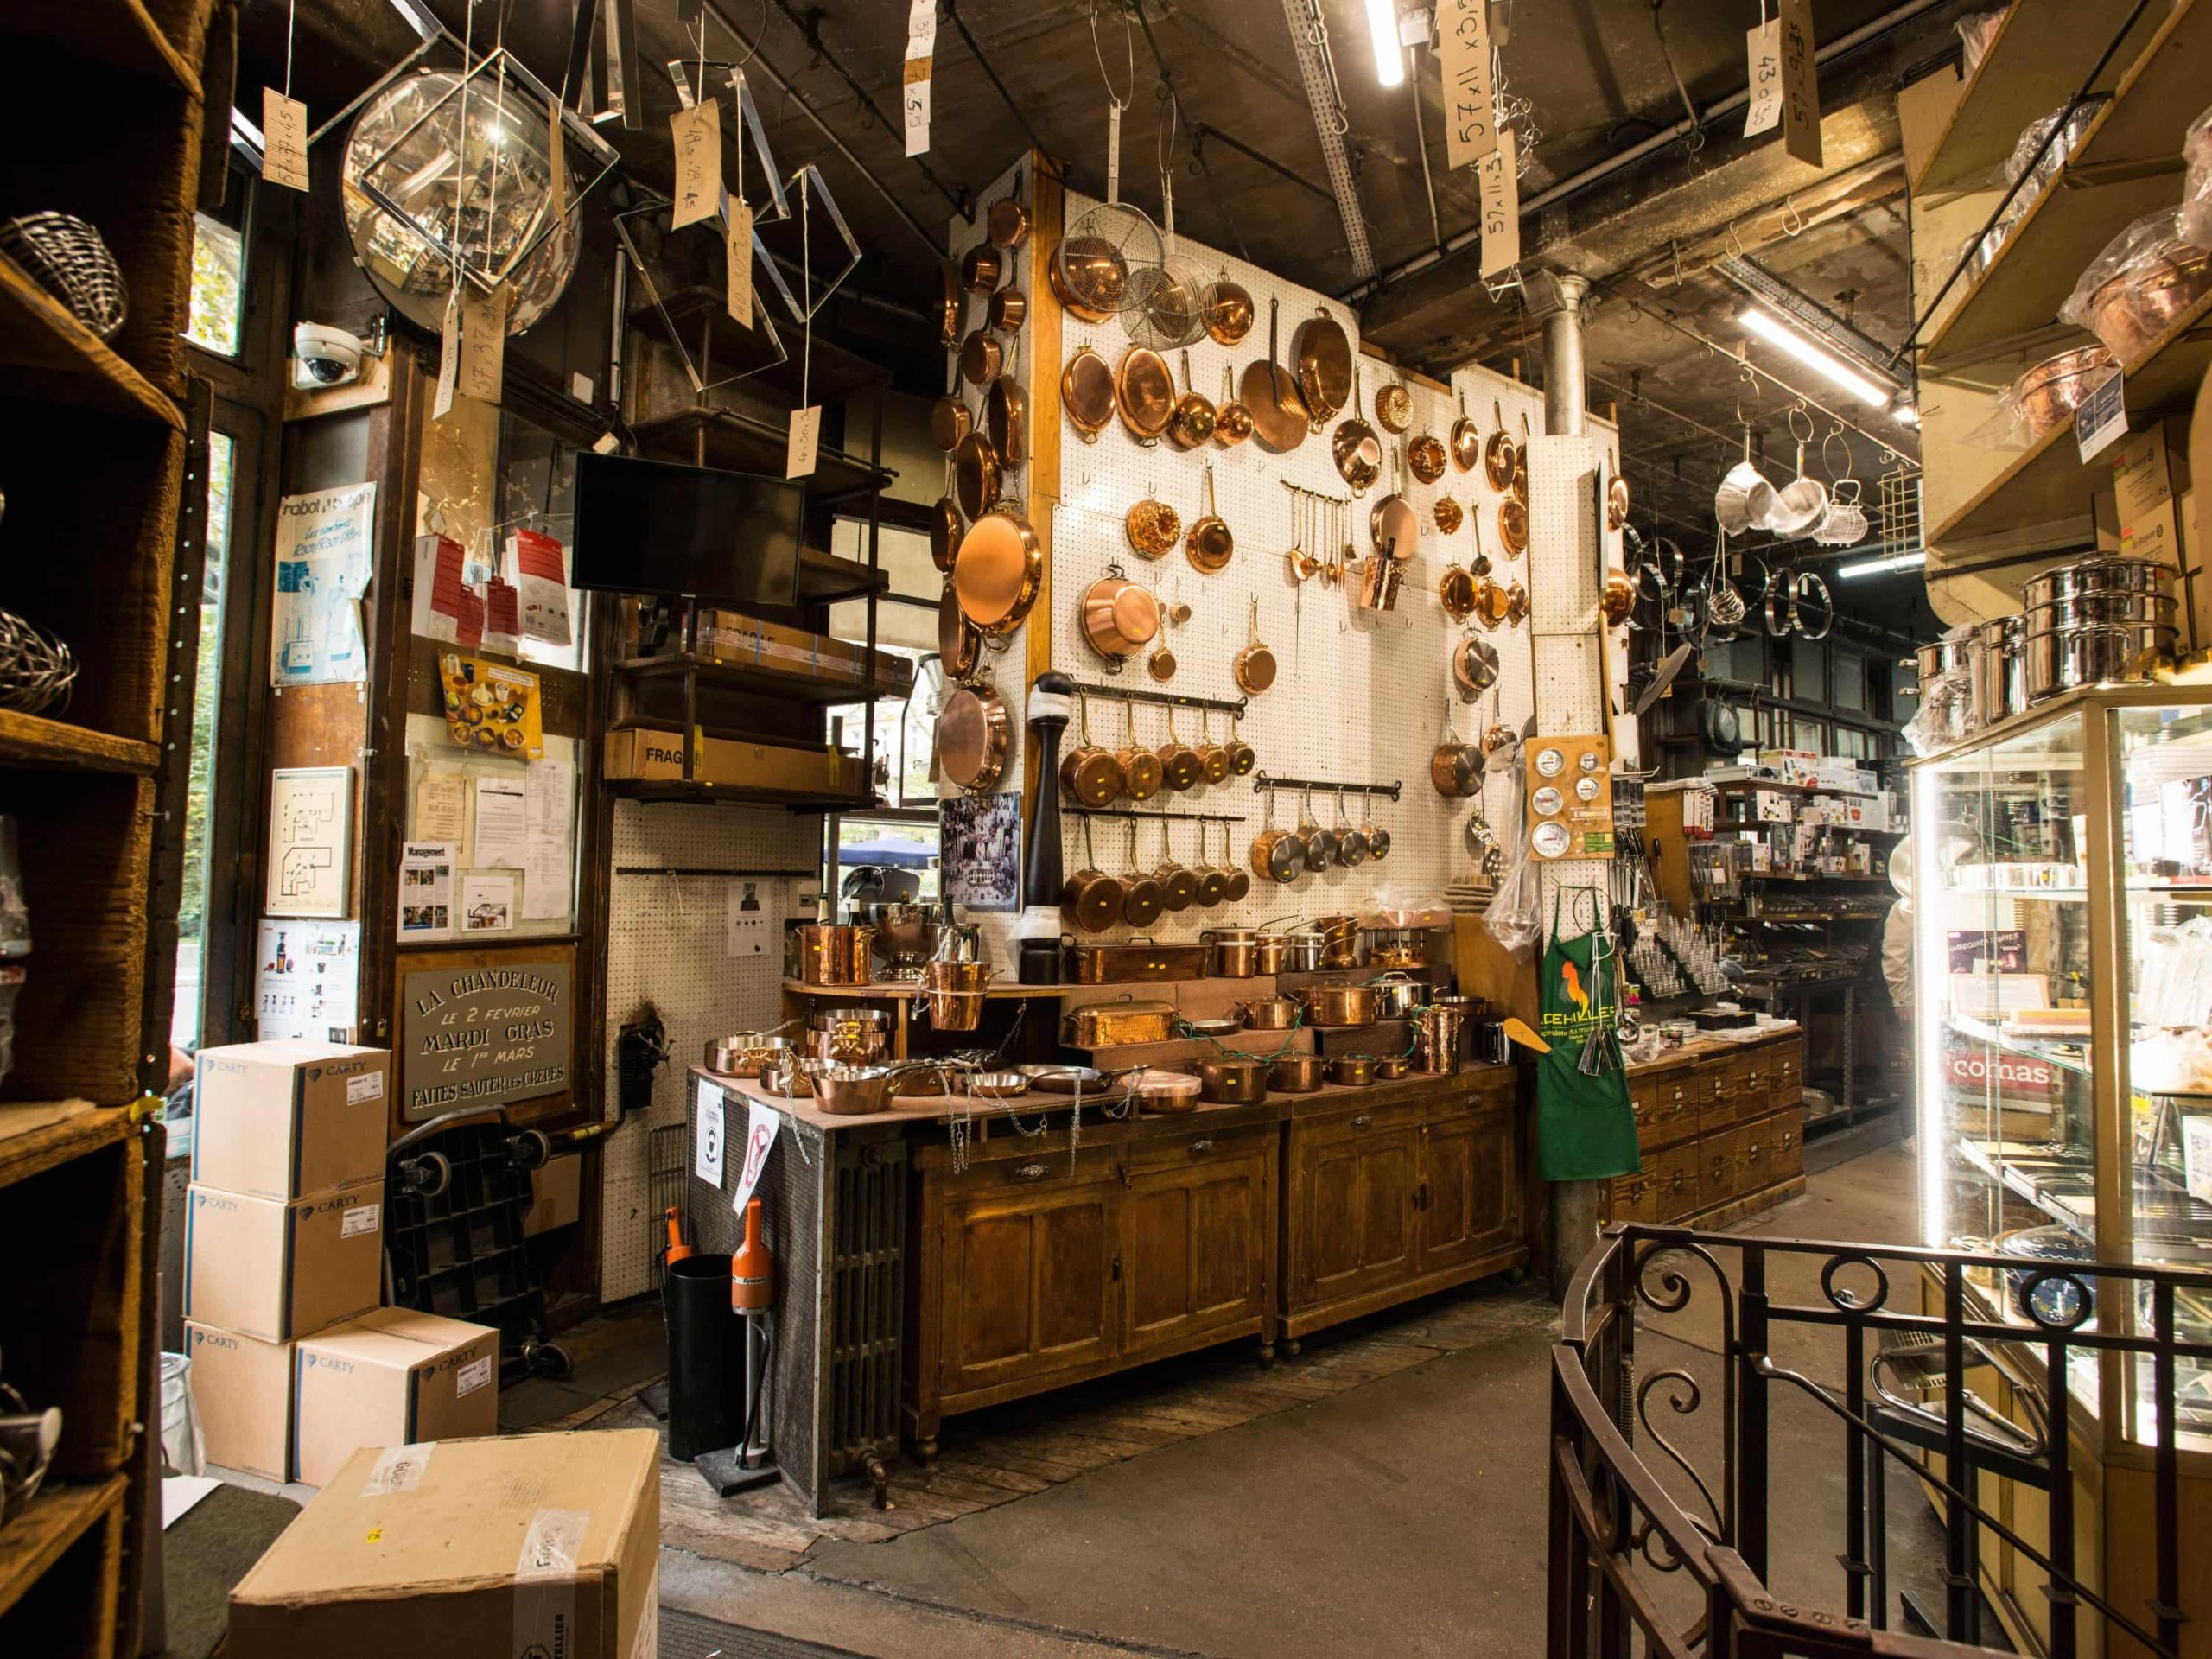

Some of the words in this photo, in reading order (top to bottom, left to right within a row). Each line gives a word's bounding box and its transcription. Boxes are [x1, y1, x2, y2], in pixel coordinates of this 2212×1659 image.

[283, 499, 320, 516] robot
[726, 626, 775, 643] FRAGLE
[646, 747, 683, 764] FRAG
[408, 846, 445, 858] Management
[416, 989, 446, 1017] LA
[450, 969, 559, 1005] CHANDELEUR
[442, 1013, 458, 1026] LE
[467, 1007, 479, 1022] 2
[484, 1005, 541, 1020] FEVRIER
[420, 1028, 491, 1055] MARDI
[505, 1020, 555, 1043] GRAS
[442, 1058, 461, 1072] LE
[493, 1046, 536, 1065] MARS
[326, 1061, 367, 1077] CARTY
[1953, 1059, 2050, 1084] comas
[412, 1084, 459, 1109] FAITES
[460, 1075, 507, 1100] SAUTER
[318, 1194, 361, 1212] CARTY
[207, 1335, 240, 1351] CARTY
[319, 1357, 355, 1375] CARTY
[438, 1346, 478, 1372] CARTY
